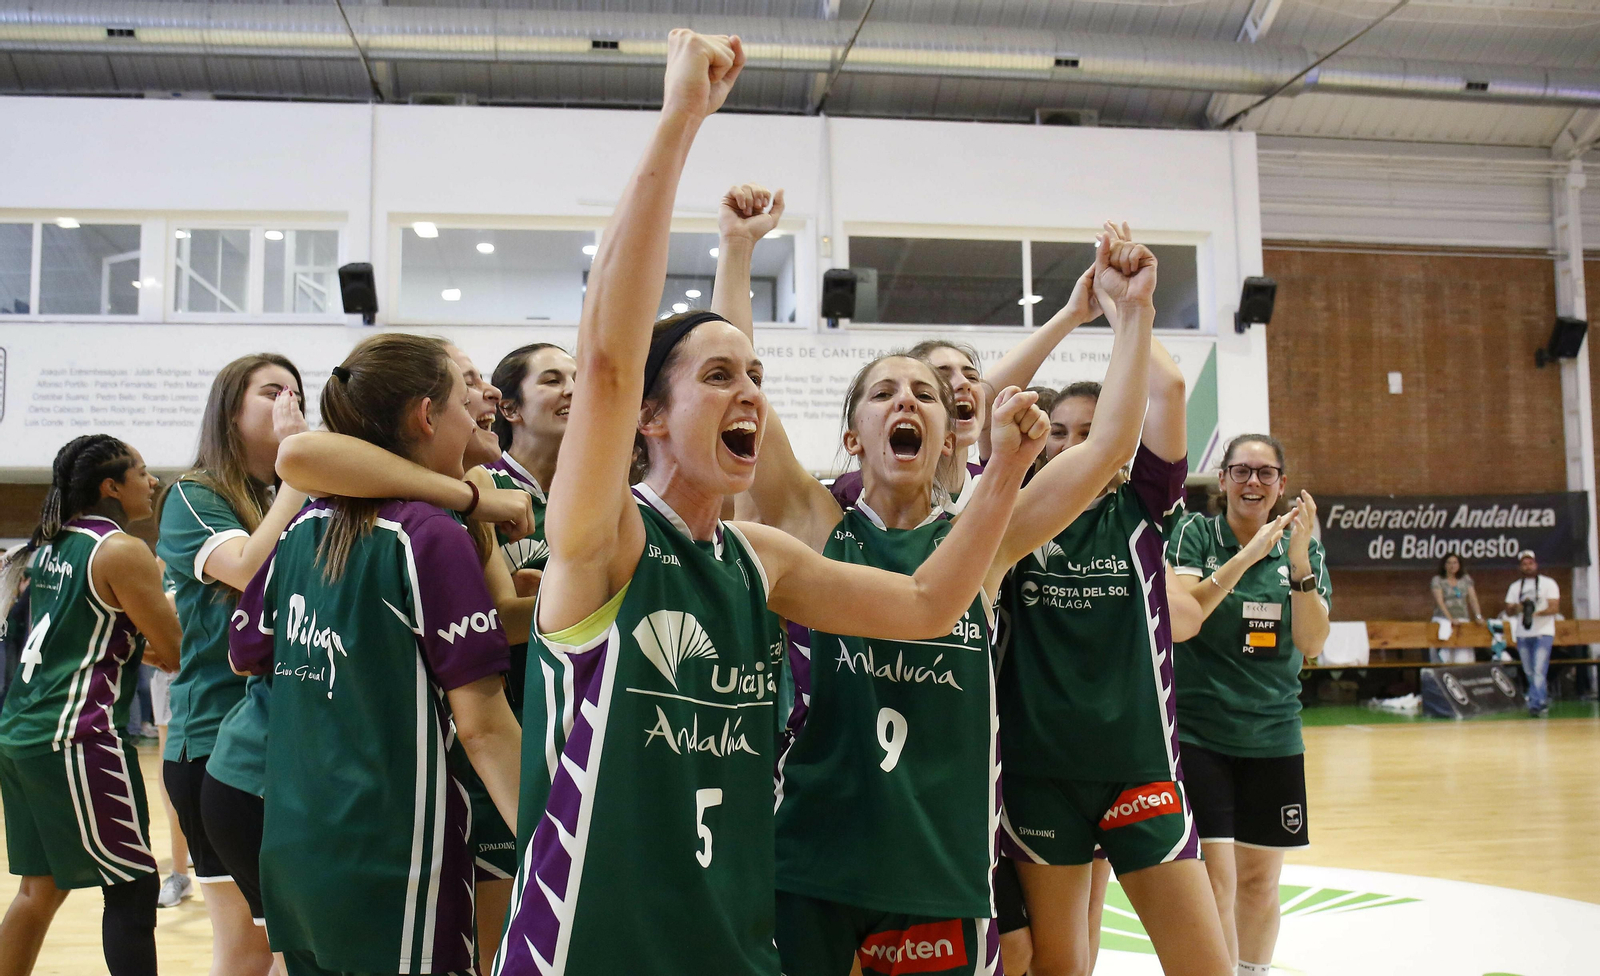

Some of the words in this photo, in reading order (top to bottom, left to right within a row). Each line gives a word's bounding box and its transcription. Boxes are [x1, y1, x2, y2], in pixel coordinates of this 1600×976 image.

[799, 347, 816, 358] DE
[1061, 352, 1075, 363] EL
[1326, 503, 1448, 529] Federación
[1450, 503, 1556, 528] Andaluza
[1368, 534, 1395, 560] de
[1401, 533, 1520, 560] Baloncesto
[1042, 584, 1080, 598] COSTA
[1083, 585, 1106, 597] DEL
[1108, 585, 1130, 597] SOL
[1042, 595, 1092, 609] MÁLAGA
[437, 608, 499, 645] wor
[1248, 620, 1275, 629] STAFF
[21, 612, 51, 684] 4
[1242, 646, 1255, 654] PG
[876, 706, 908, 773] 9
[1103, 790, 1174, 822] worten
[695, 787, 723, 868] 5
[1019, 826, 1055, 839] SPALDING
[478, 841, 515, 853] SPALDING
[861, 938, 954, 963] worten
